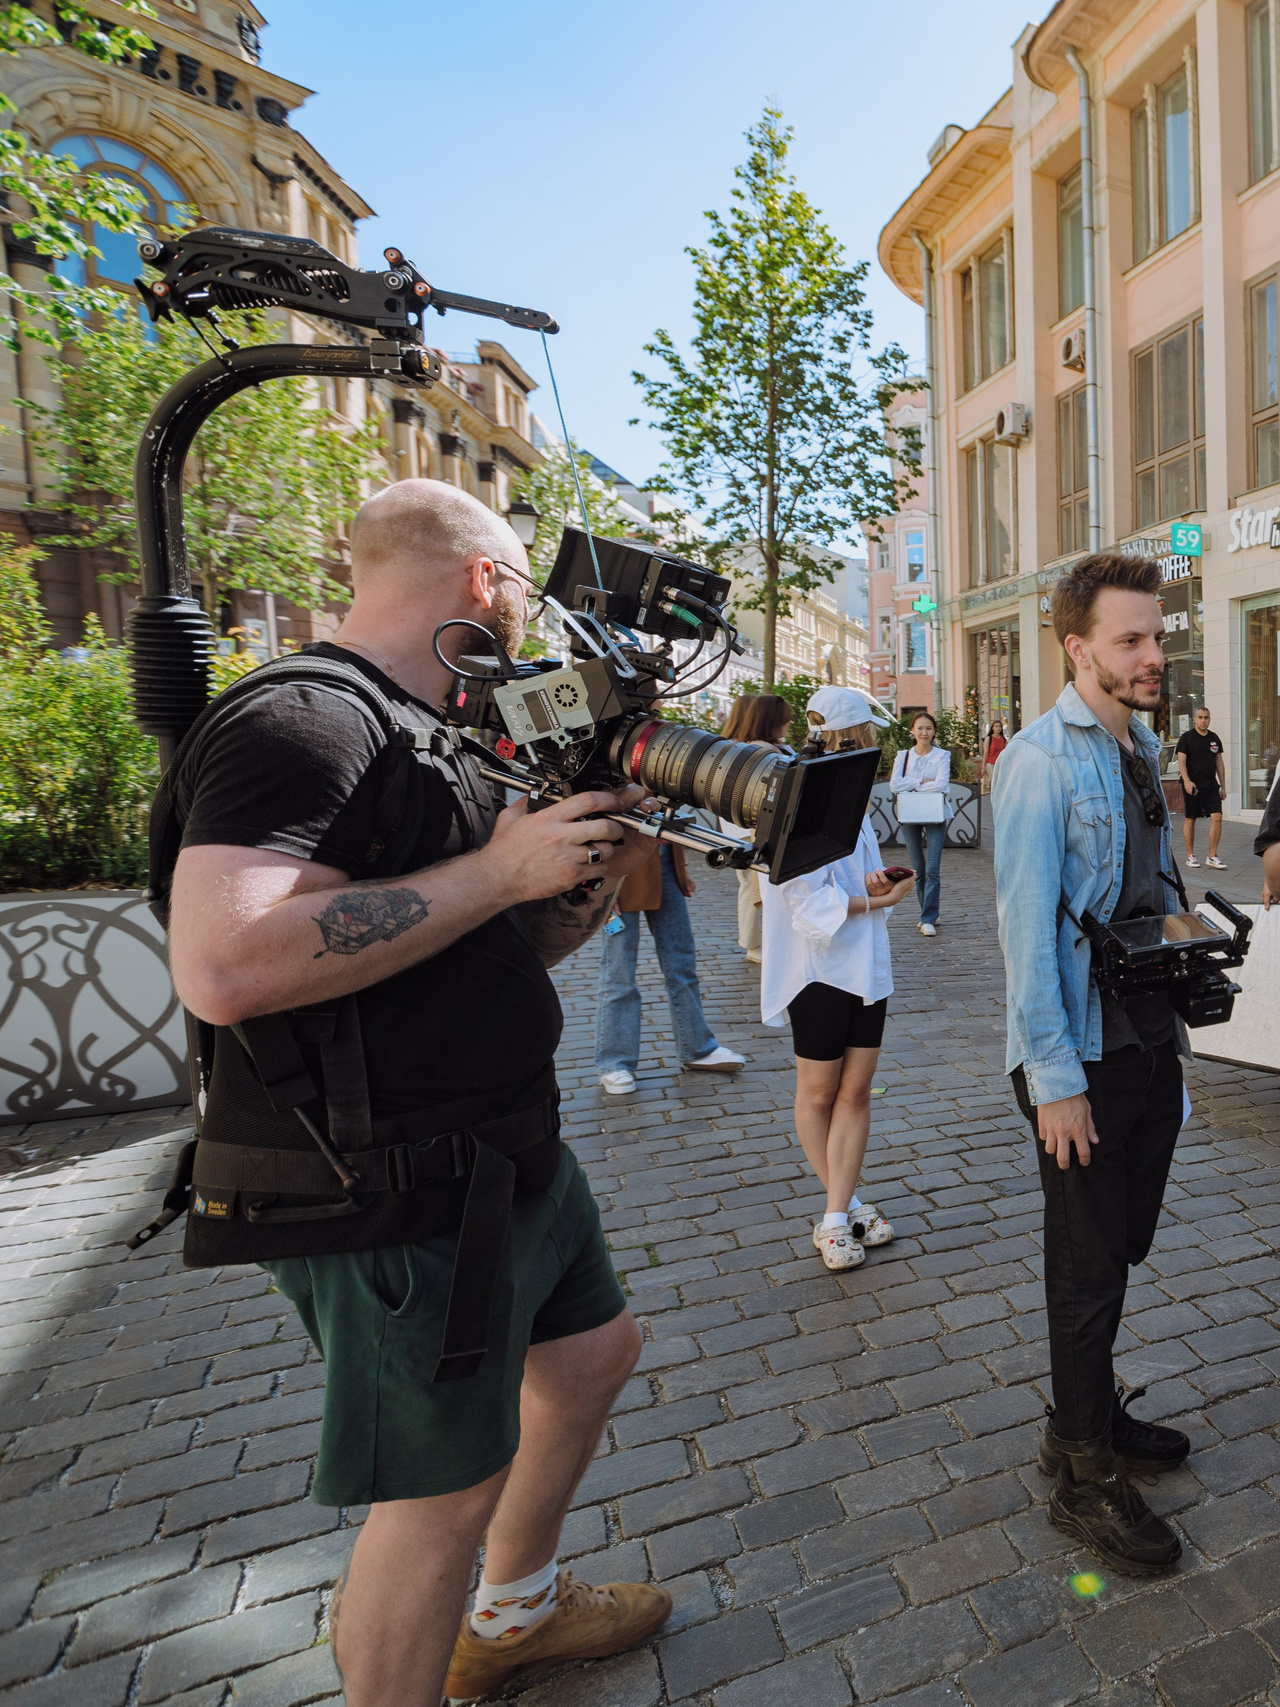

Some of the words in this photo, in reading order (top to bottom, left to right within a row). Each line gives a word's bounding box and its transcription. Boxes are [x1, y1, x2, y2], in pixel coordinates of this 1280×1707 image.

[1176, 529, 1199, 548] 59
[208, 1200, 221, 1209] Made
[208, 1207, 226, 1216] Sweden
